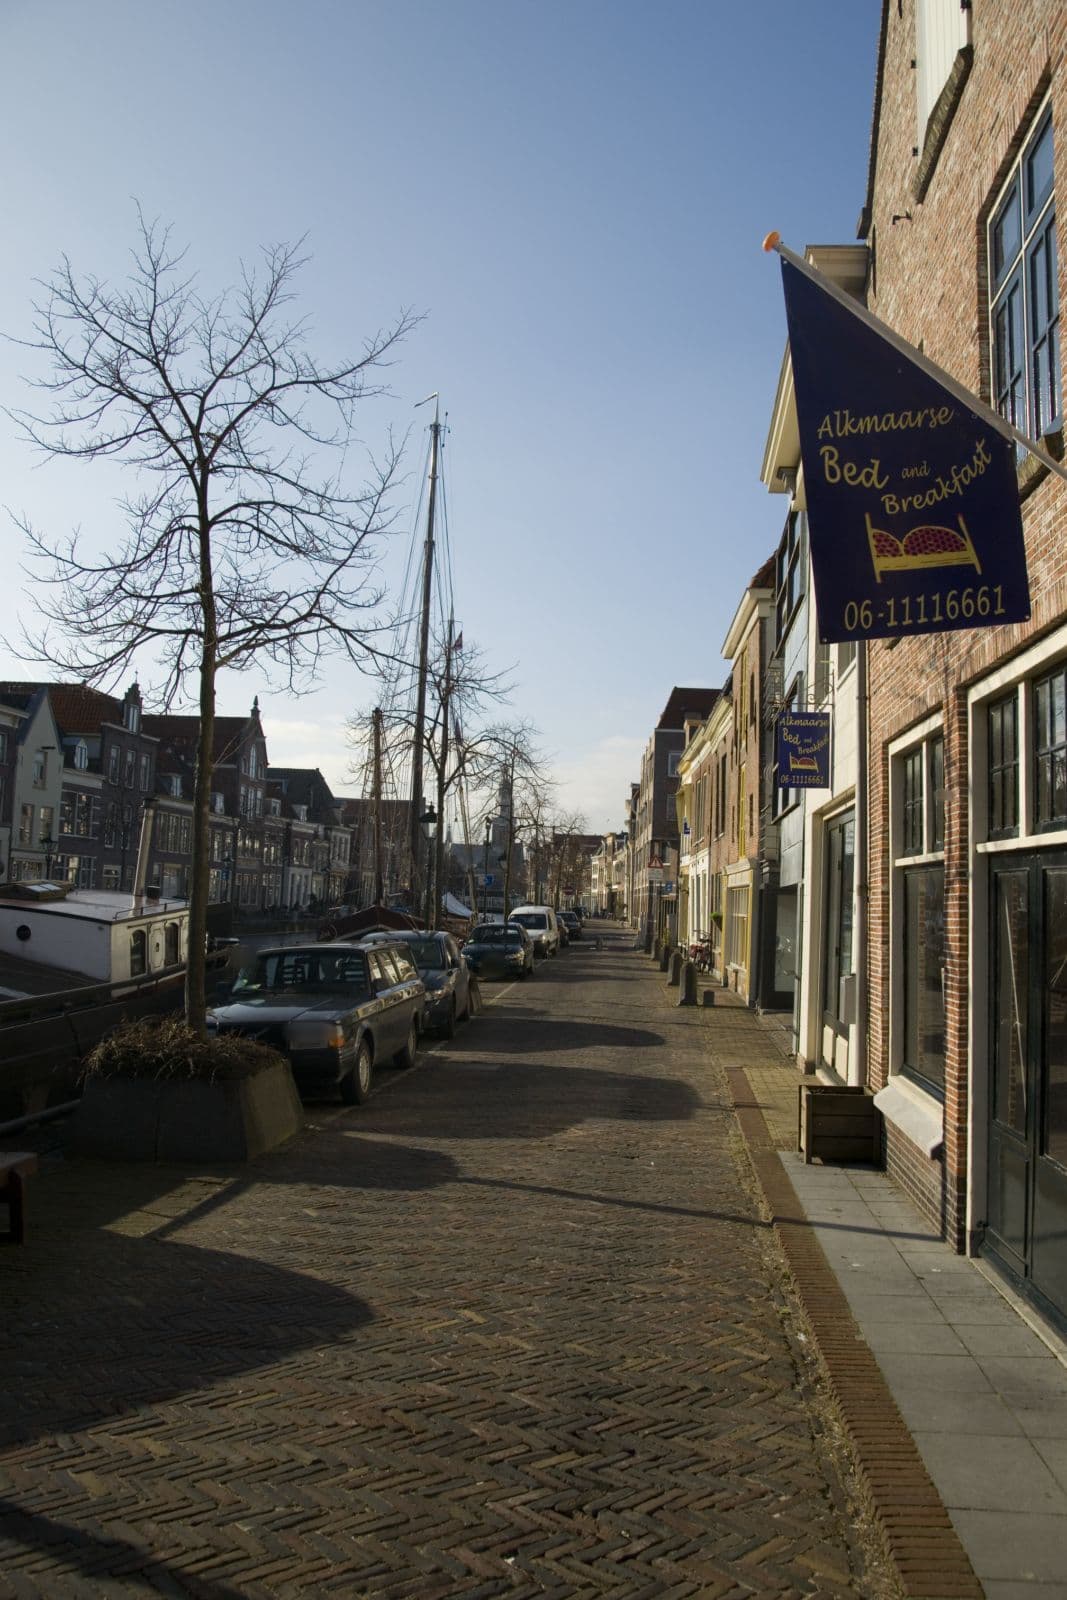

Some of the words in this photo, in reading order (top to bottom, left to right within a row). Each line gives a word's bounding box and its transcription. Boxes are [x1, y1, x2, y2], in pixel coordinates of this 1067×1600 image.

[817, 406, 954, 440] Alkmaarse
[820, 445, 890, 489] Bed
[901, 461, 930, 480] and
[881, 438, 992, 515] Breakfast
[844, 585, 1005, 631] 06-11116661
[782, 728, 801, 745] Bed
